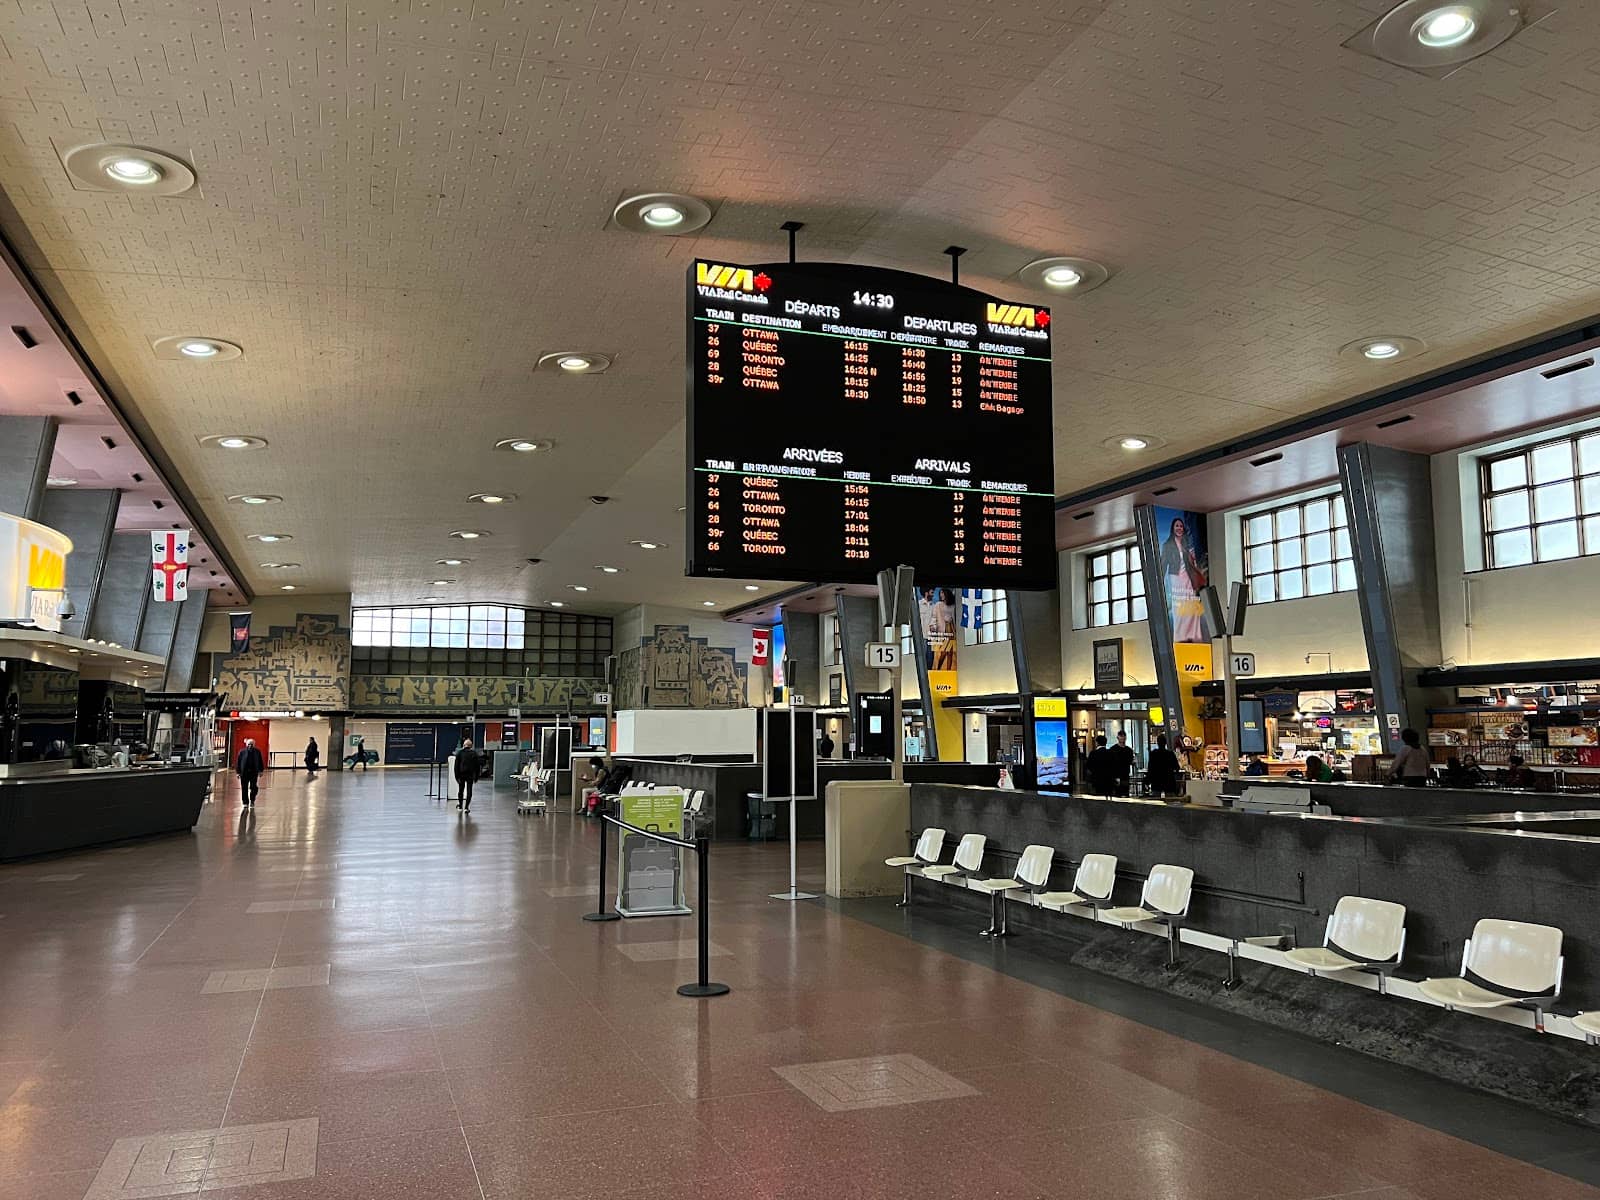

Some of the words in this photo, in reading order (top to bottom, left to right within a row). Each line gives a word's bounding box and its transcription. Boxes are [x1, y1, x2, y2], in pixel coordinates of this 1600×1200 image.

[697, 263, 753, 290] VIA
[735, 291, 768, 304] Canada
[853, 290, 894, 309] 14:30
[706, 309, 734, 320] TRAIN
[742, 313, 801, 328] DESTINATION
[785, 300, 840, 318] DÉPARTS
[987, 303, 1035, 326] VIA
[904, 316, 977, 335] DEPARTURES
[1020, 328, 1048, 339] Canada
[708, 325, 719, 333] 37
[743, 329, 779, 340] OTTAWA
[902, 348, 925, 358] 16:30
[952, 353, 961, 361] 13
[708, 337, 719, 346] 26
[743, 340, 778, 352] QUÉBEC
[902, 360, 925, 369] 16:40
[952, 365, 961, 373] 17
[708, 350, 719, 358] 69
[743, 353, 785, 366] TORONTO
[902, 371, 925, 381] 16:56
[952, 377, 961, 385] 19
[708, 362, 719, 371] 28
[743, 366, 778, 378] QUÉBEC
[903, 383, 926, 393] 18:25
[952, 389, 962, 397] 15
[743, 379, 779, 390] OTTAWA
[903, 395, 926, 405] 18:50
[952, 400, 962, 408] 13
[706, 460, 735, 469] TRAIN
[783, 448, 843, 464] ARRIVÉES
[915, 459, 970, 473] ARRIVALS
[708, 474, 719, 483] 37
[743, 477, 778, 487] QUÉBEC
[708, 488, 719, 496] 26
[743, 491, 780, 501] OTTAWA
[954, 505, 964, 513] 17
[708, 501, 719, 510] 64
[743, 503, 785, 514] TORONTO
[954, 518, 964, 526] 14
[708, 515, 719, 523] 28
[743, 517, 780, 527] OTTAWA
[708, 542, 719, 551] 66
[743, 544, 785, 555] TORONTO
[743, 530, 778, 541] QUÉBEC
[954, 543, 964, 551] 13
[876, 648, 894, 663] 15
[1234, 657, 1250, 672] 16
